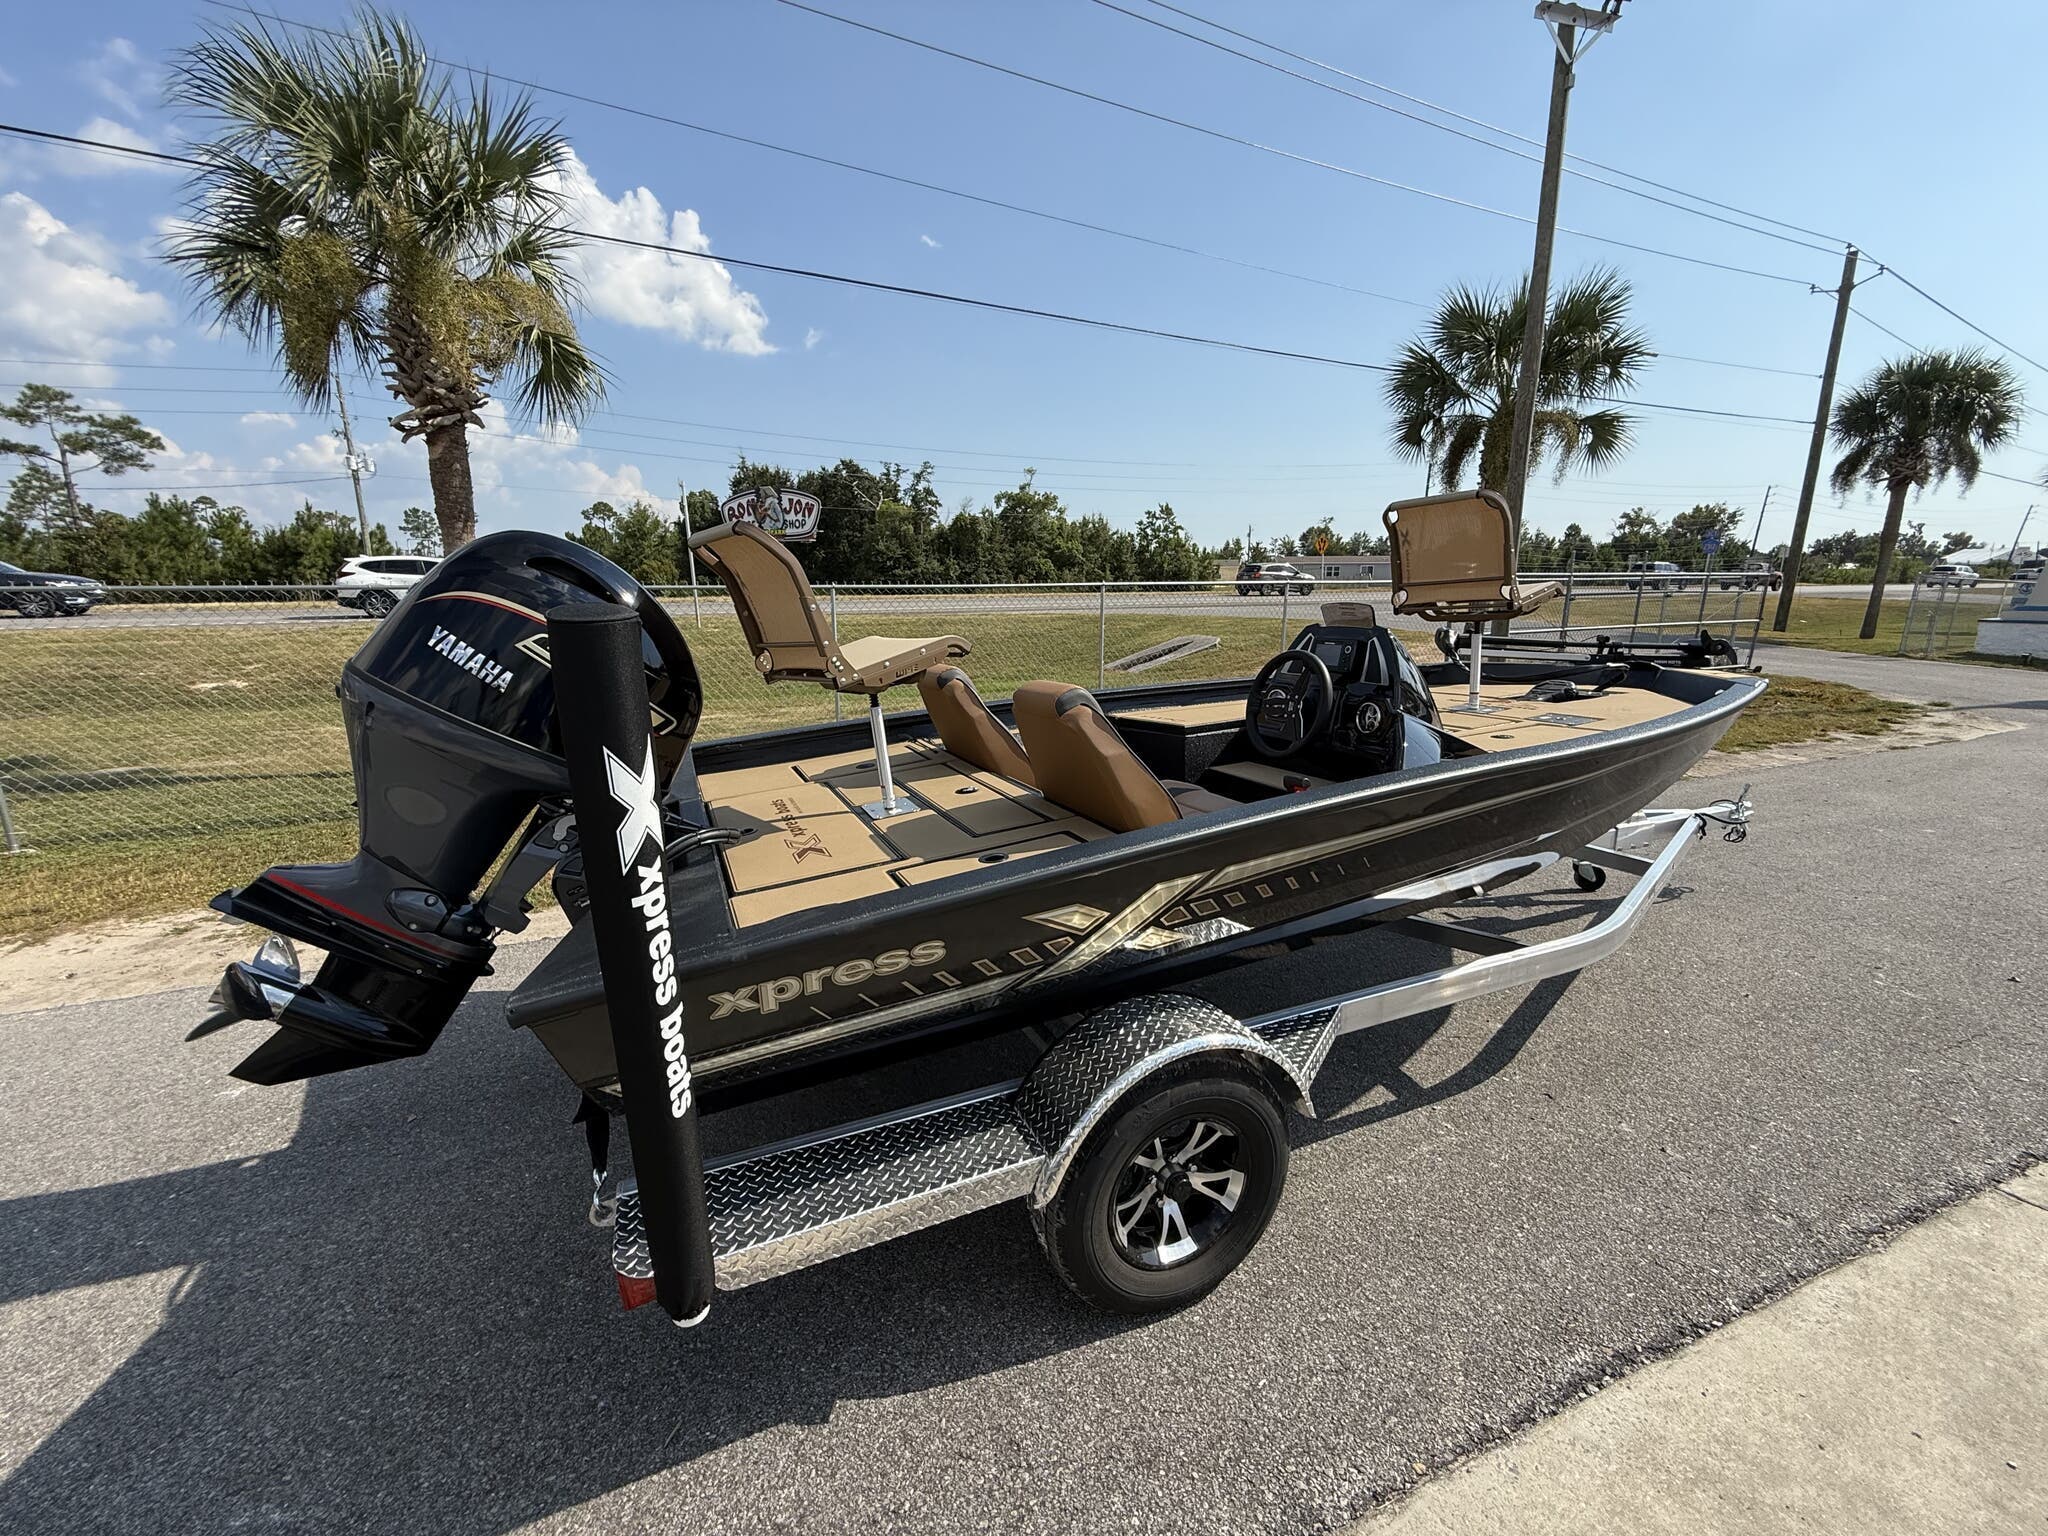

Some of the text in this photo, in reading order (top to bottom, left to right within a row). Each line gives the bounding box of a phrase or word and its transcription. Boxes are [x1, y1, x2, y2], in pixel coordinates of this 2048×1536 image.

[783, 498, 815, 519] JON
[784, 519, 806, 529] SHOP
[427, 625, 514, 693] YAMAHA
[631, 855, 692, 1118] xpress boats
[708, 940, 947, 1020] xpress
